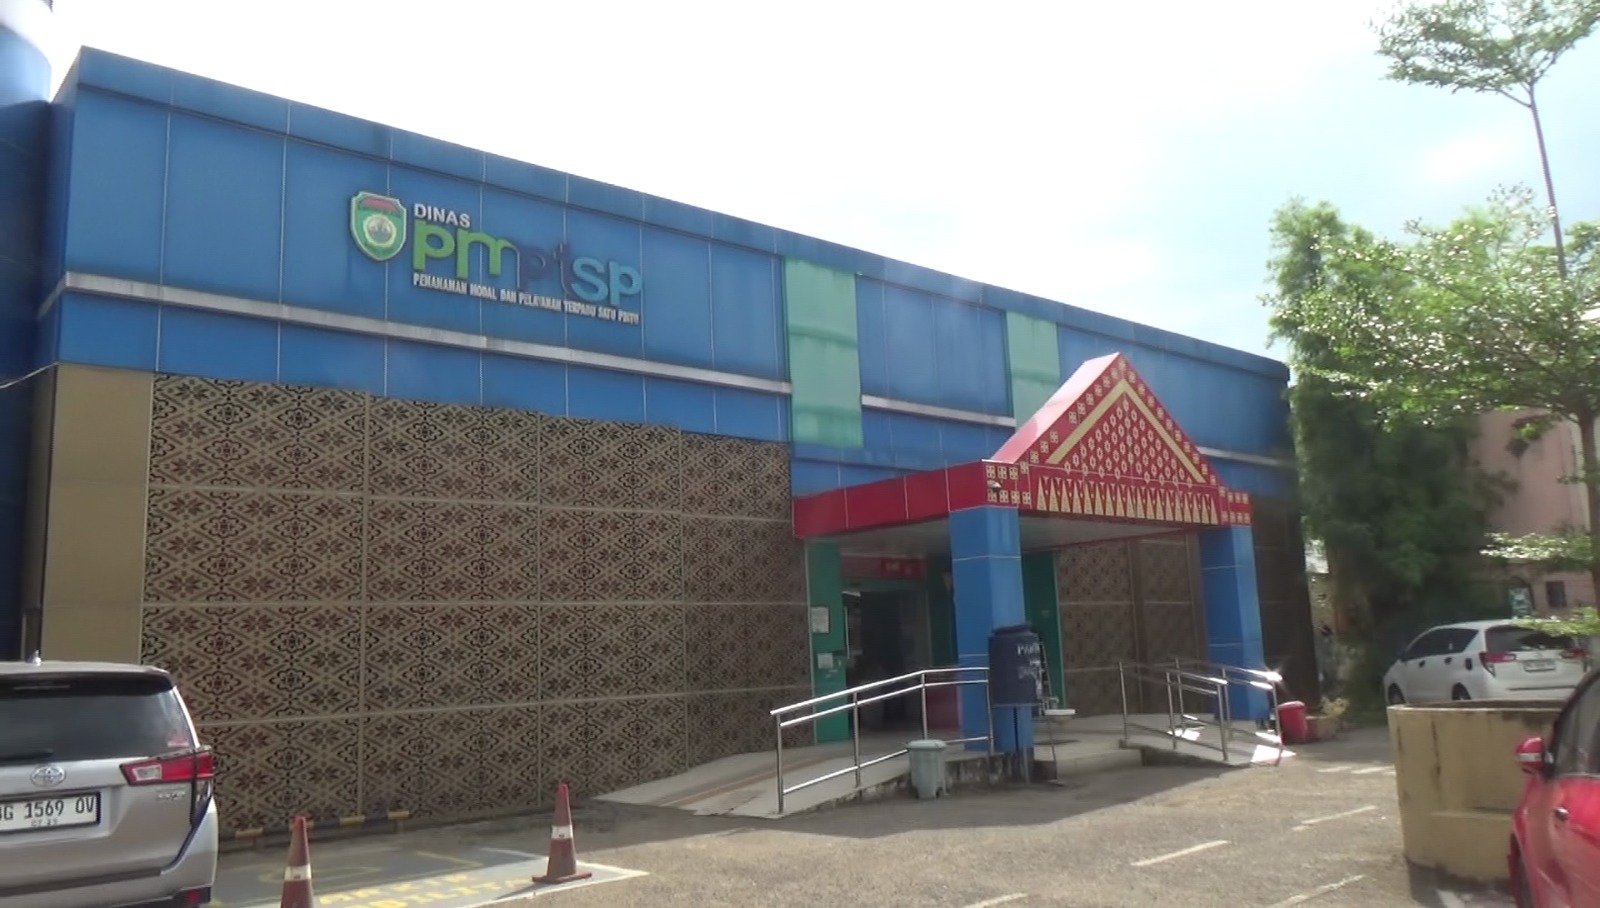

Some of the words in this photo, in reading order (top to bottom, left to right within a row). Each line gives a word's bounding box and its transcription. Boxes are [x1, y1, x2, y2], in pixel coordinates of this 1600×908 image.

[414, 203, 471, 228] DINAS
[412, 272, 468, 295] PENANAMAN
[469, 283, 498, 301] MODAL
[499, 289, 518, 304] DAN
[562, 299, 597, 318] TERPADU
[596, 305, 617, 322] SATU
[0, 805, 14, 821] G
[24, 800, 65, 819] 1569
